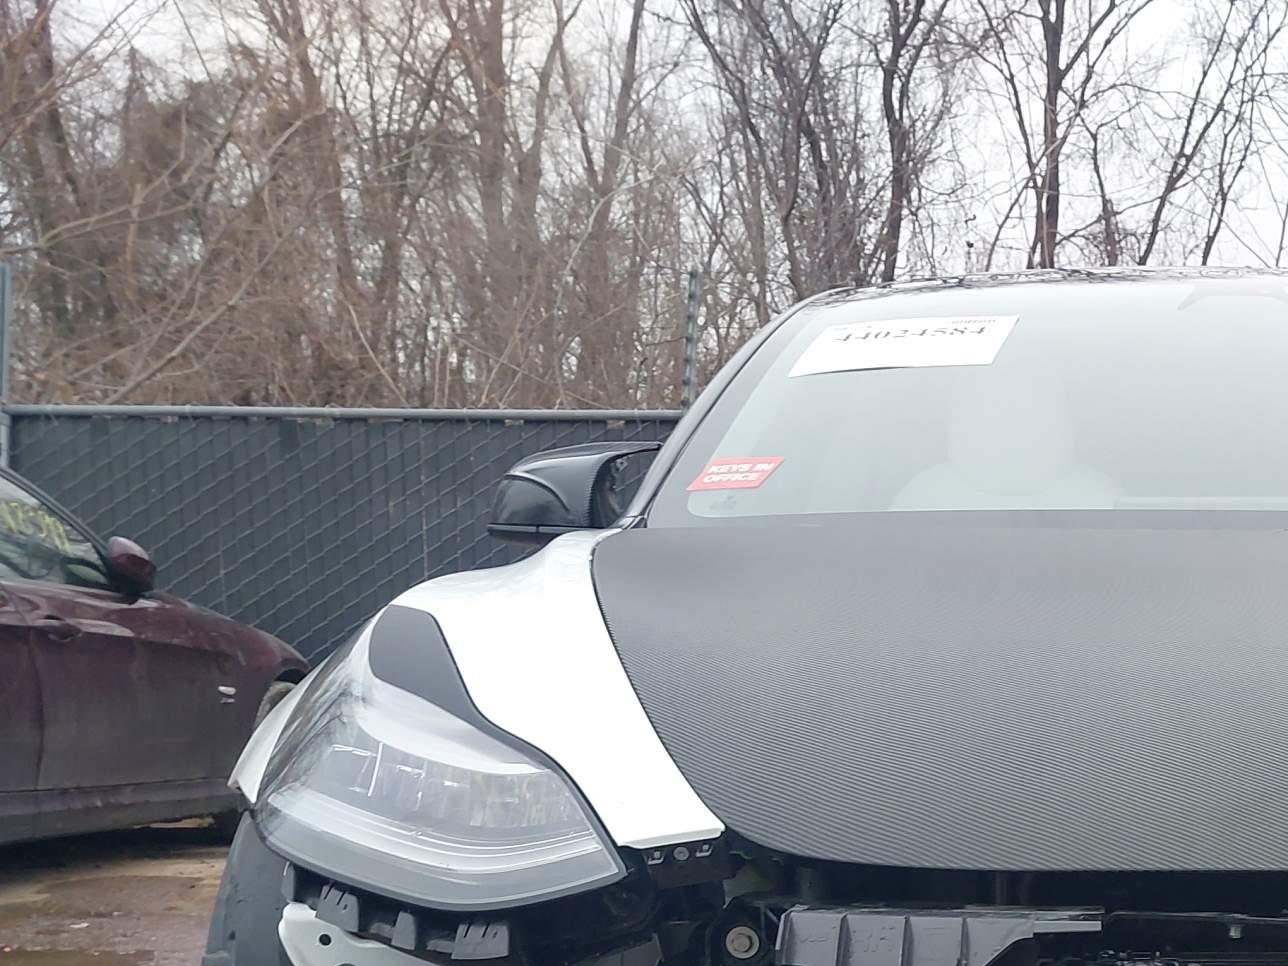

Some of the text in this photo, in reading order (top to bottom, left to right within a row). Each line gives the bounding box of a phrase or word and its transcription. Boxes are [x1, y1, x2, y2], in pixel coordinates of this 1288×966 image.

[833, 326, 987, 343] 44024584
[708, 463, 775, 474] KEYS IN
[703, 472, 760, 483] OFFICE
